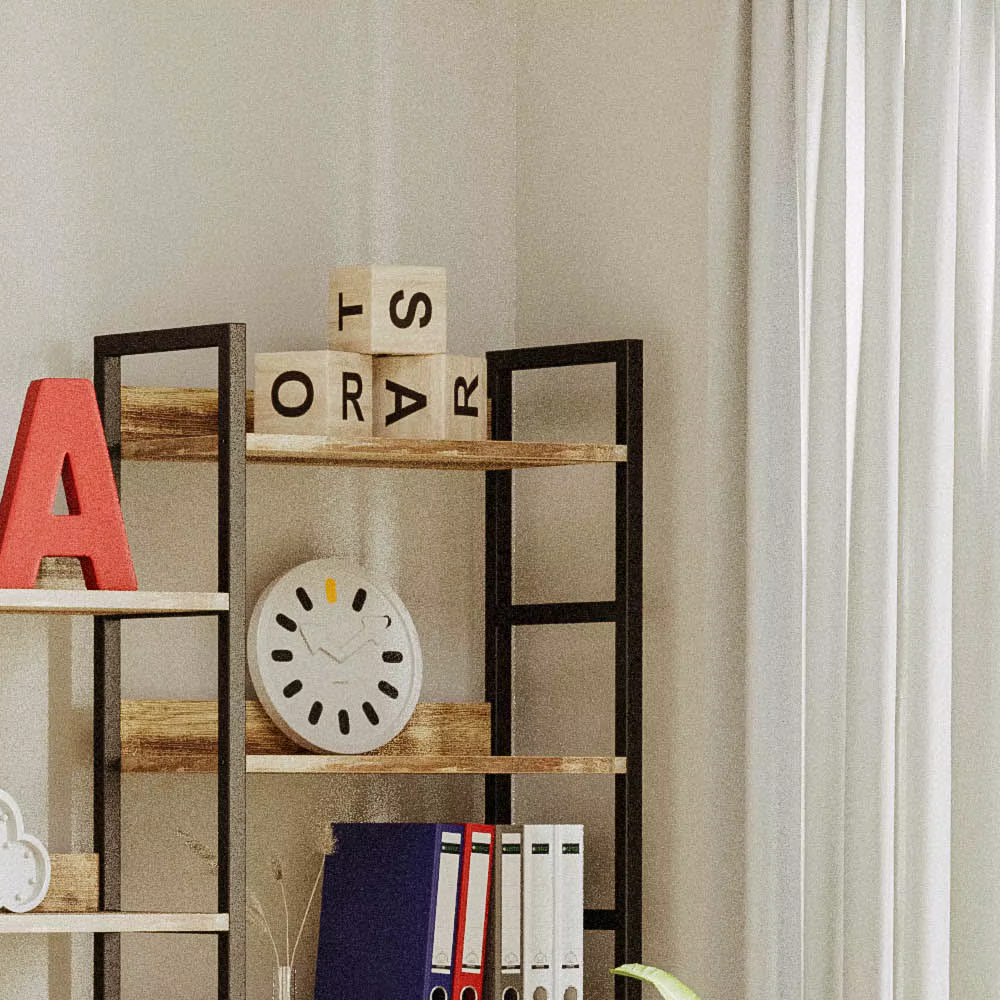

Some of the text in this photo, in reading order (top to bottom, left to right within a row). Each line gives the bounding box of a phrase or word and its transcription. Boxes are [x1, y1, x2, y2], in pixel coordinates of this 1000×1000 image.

[338, 292, 363, 331] T
[389, 290, 432, 329] S
[271, 370, 314, 418] O
[342, 371, 364, 422] R
[385, 379, 427, 427] A
[454, 375, 479, 417] R
